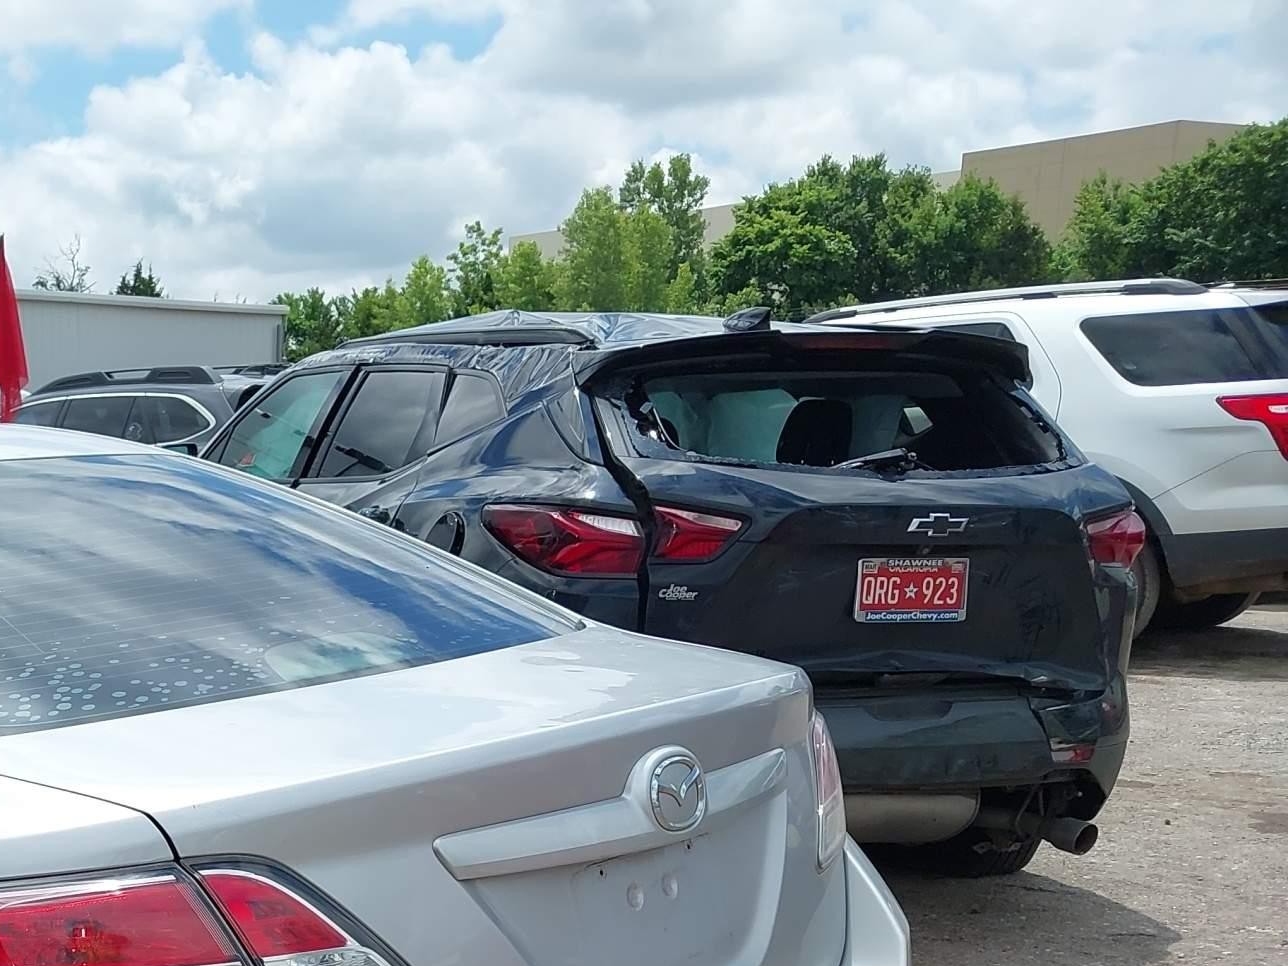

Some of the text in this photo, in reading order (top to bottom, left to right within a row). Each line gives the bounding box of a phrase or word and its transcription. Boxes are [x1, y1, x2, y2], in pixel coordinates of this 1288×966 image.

[667, 583, 688, 593] Joe
[922, 576, 959, 605] 923
[658, 588, 699, 600] Cooper
[866, 612, 958, 621] JoeCooperChevy.com
